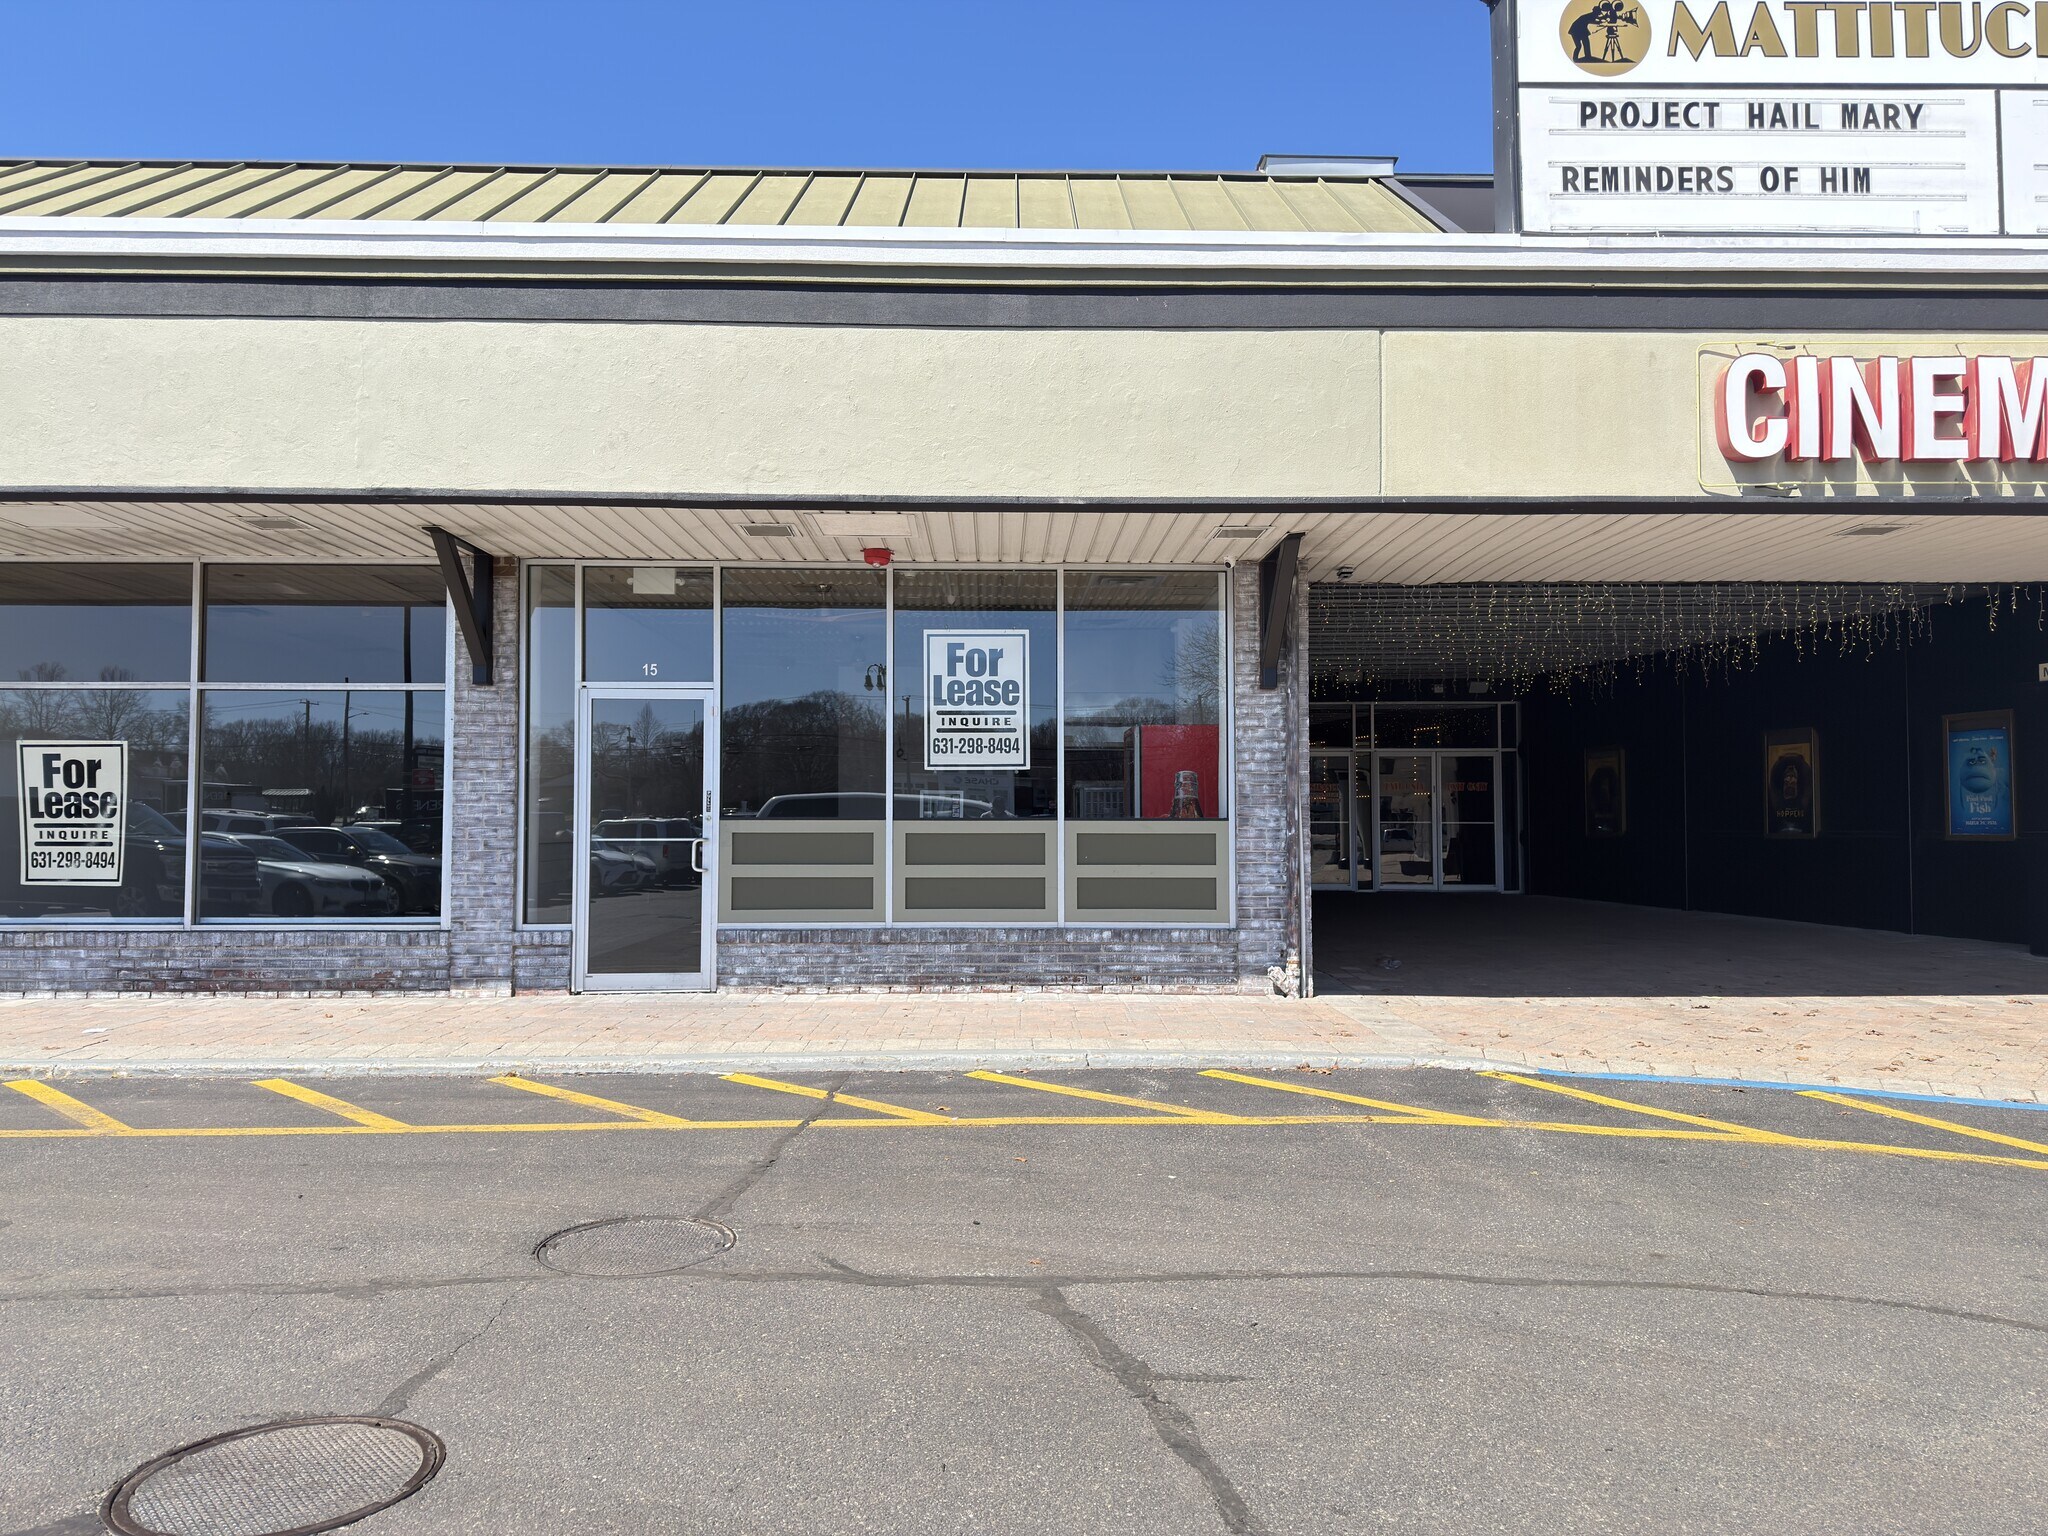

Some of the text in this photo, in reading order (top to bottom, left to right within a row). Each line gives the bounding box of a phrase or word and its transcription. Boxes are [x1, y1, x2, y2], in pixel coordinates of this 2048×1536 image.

[1579, 101, 1925, 131] PROJECT HAIL MARY
[1561, 166, 1872, 194] REMINDERS OF HIM
[1715, 352, 2048, 463] CINEM
[642, 663, 658, 676] 15
[947, 642, 1004, 678] For
[933, 675, 1020, 706] Lease
[941, 717, 1012, 727] INQUIRE
[933, 737, 1020, 755] 631-298-8494
[42, 753, 102, 789] For
[28, 786, 118, 819] Lease
[39, 830, 109, 840] INQUIRE
[31, 851, 116, 869] 631-298-8494
